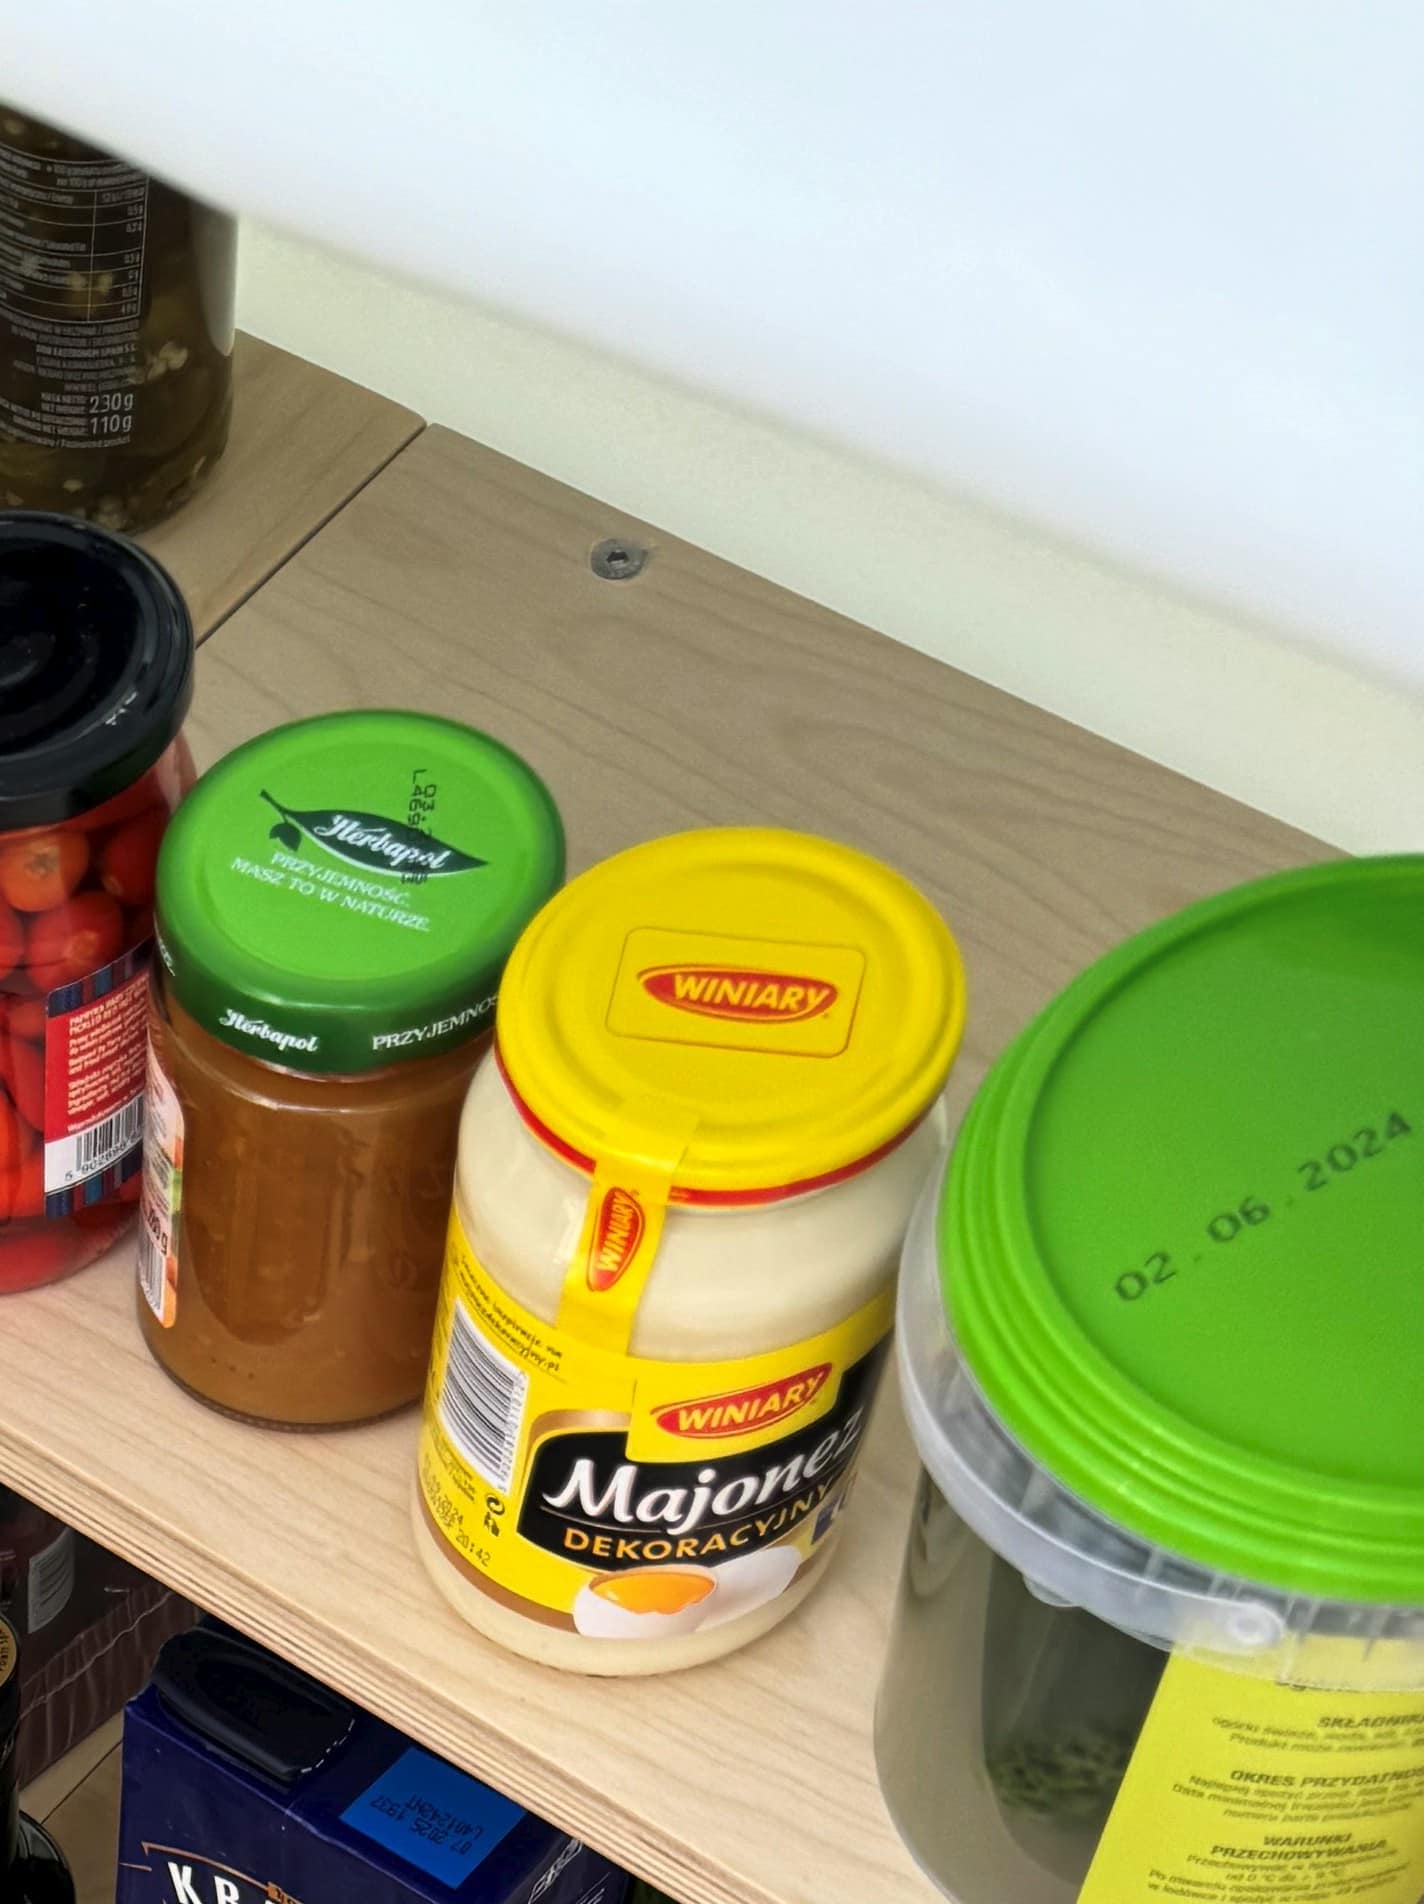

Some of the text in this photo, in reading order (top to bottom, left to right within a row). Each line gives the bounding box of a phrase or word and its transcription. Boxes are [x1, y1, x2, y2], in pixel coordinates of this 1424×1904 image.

[230, 856, 339, 904] MASZ TO W
[672, 975, 831, 1017] WINIARY
[218, 1008, 319, 1053] Herbapol
[595, 1191, 637, 1272] WINIARY
[676, 1370, 824, 1437] WINIARY
[544, 1406, 863, 1527] Majonez
[562, 1482, 831, 1562] DEKORACYJNY
[1229, 1769, 1296, 1787] OKRES
[1210, 1839, 1388, 1861] PRZECHOWYWANIA
[1262, 1833, 1353, 1848] WARUNKI
